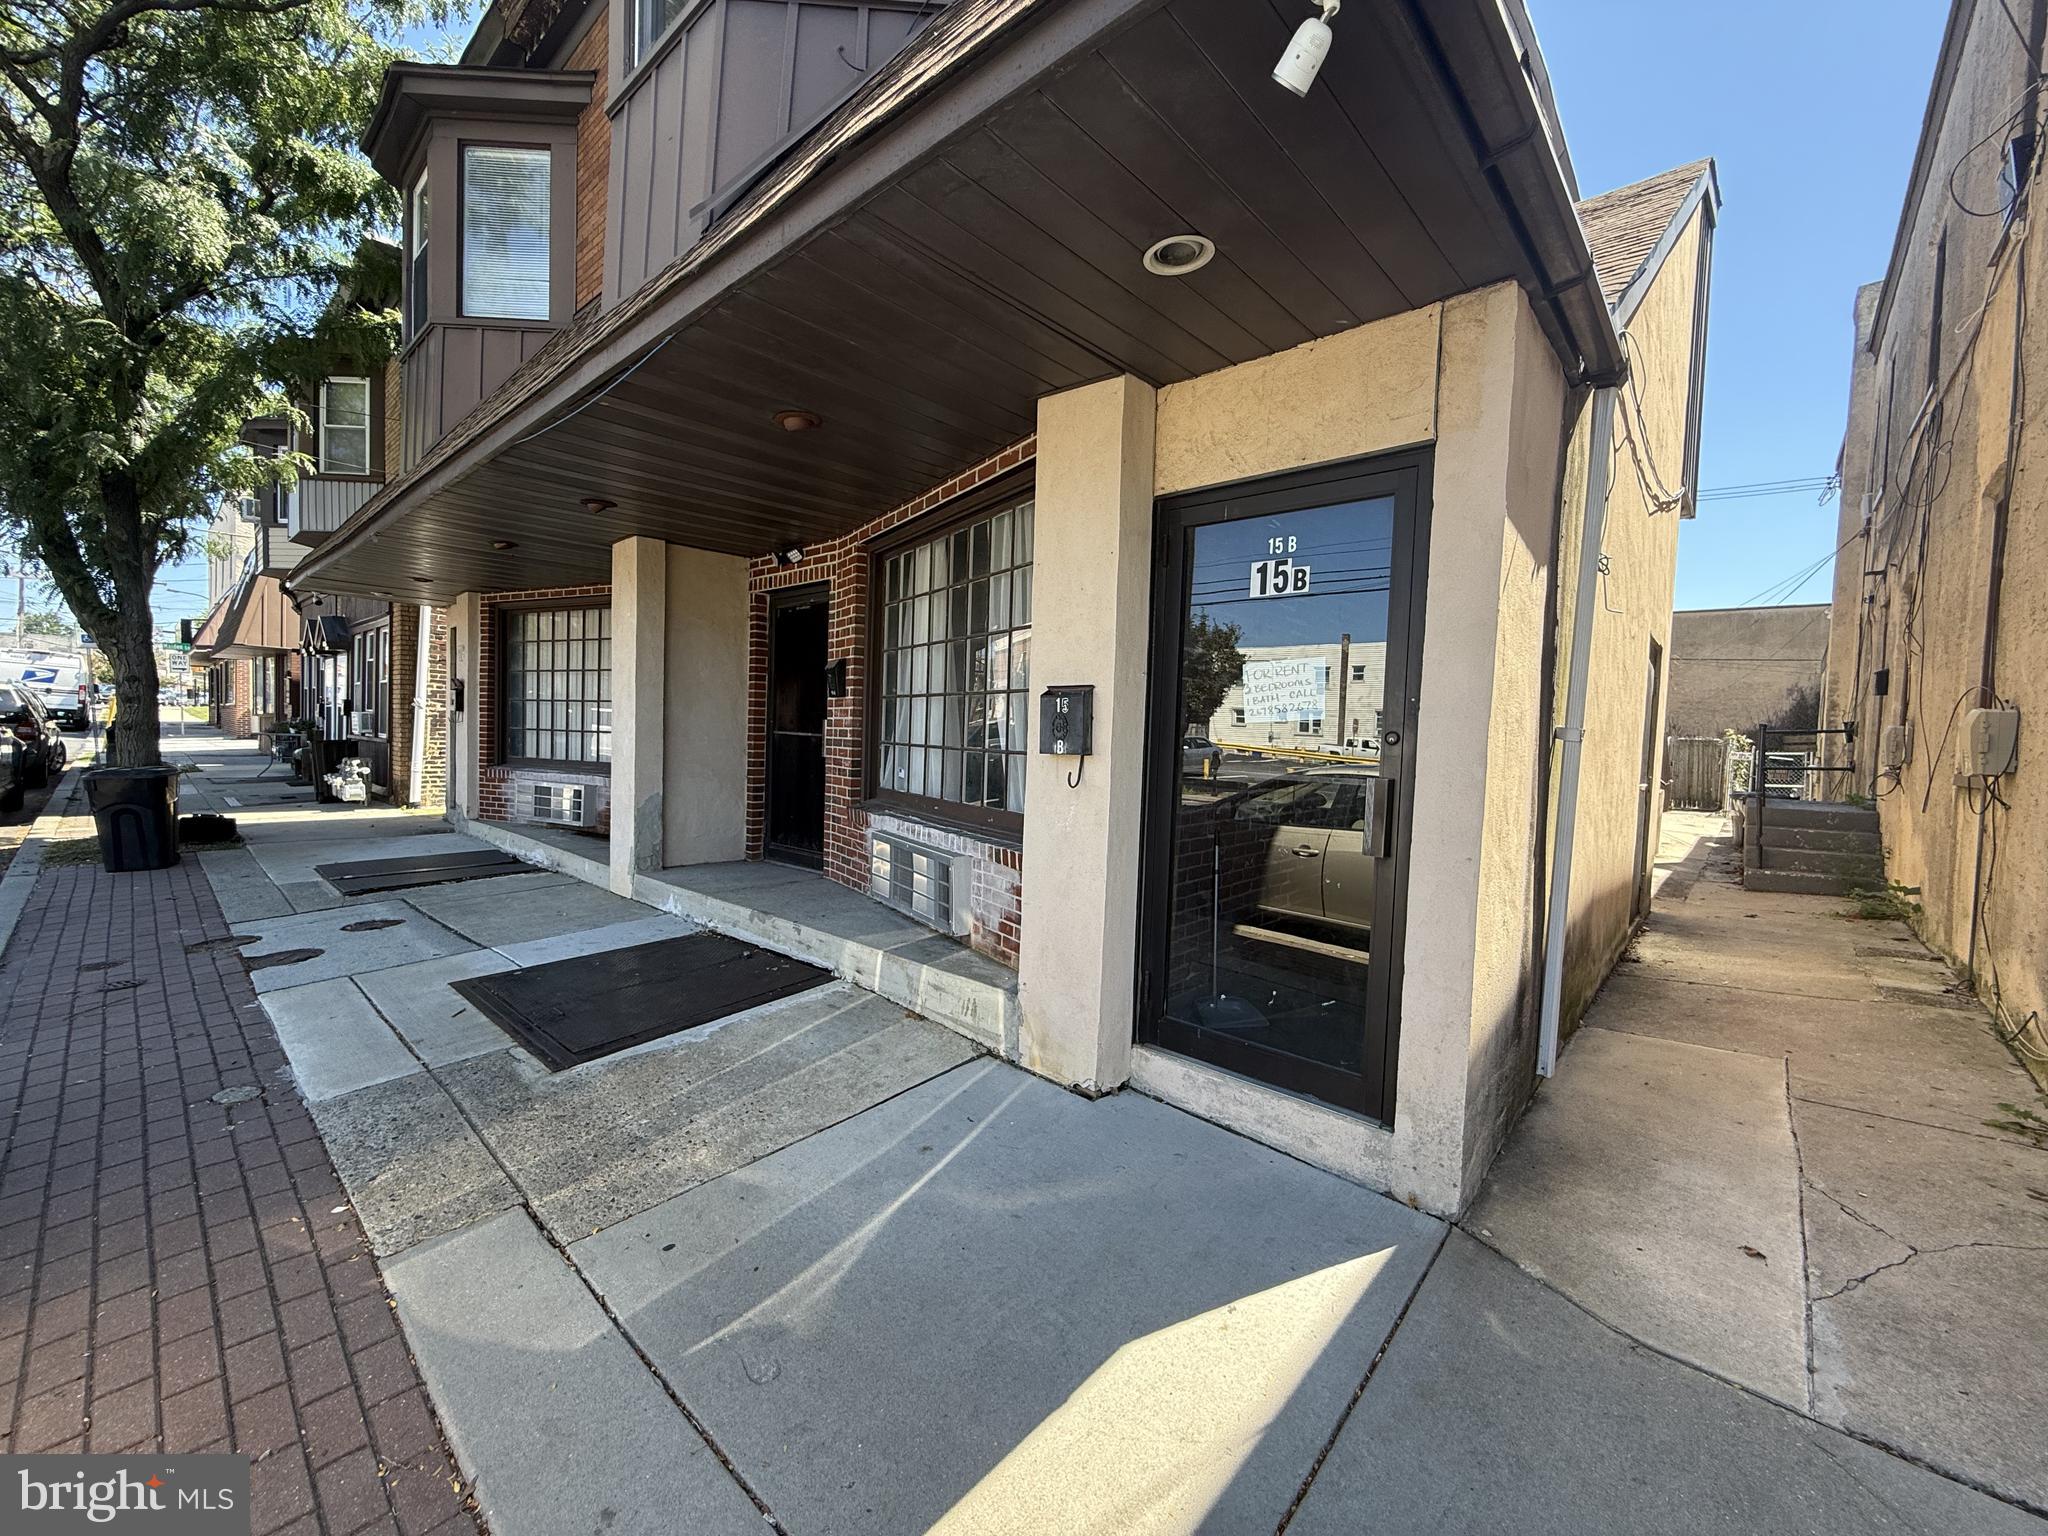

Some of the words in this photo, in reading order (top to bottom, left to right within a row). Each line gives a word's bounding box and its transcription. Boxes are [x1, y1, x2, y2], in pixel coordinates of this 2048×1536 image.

[1268, 537, 1283, 554] 15
[1288, 536, 1297, 553] B
[1256, 559, 1307, 595] 15B
[1245, 669, 1272, 682] FOR
[1275, 663, 1309, 677] RENT
[1244, 683, 1251, 695] 3
[1254, 678, 1312, 693] BEDROOMS
[1056, 698, 1069, 713] 15
[1252, 693, 1280, 705] BATH
[1289, 689, 1317, 699] CALL
